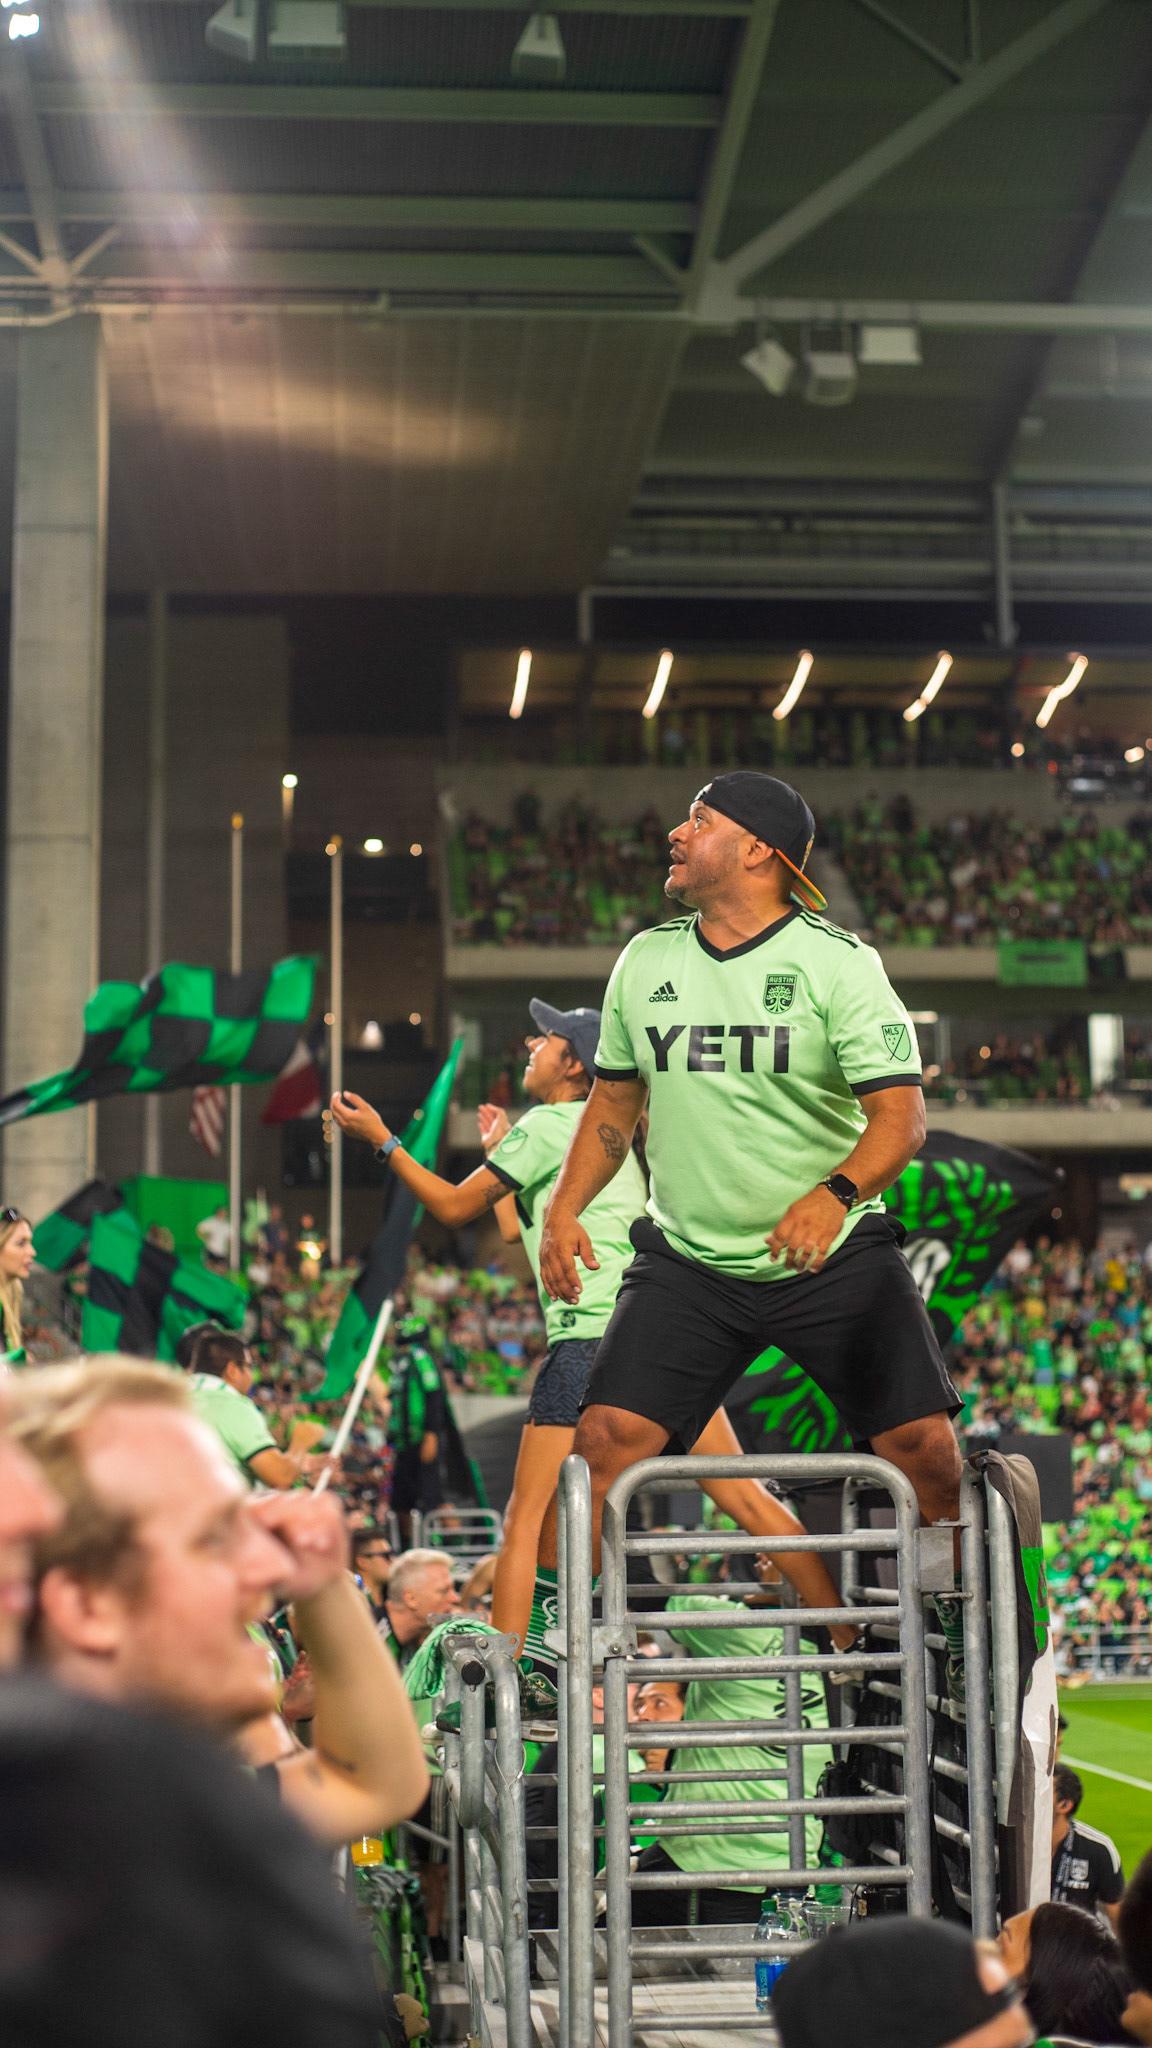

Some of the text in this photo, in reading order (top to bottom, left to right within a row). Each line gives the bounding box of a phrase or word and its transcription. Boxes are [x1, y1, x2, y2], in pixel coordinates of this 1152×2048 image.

[649, 994, 678, 1002] adidas
[884, 1027, 899, 1036] MLS
[645, 1025, 790, 1073] YETI
